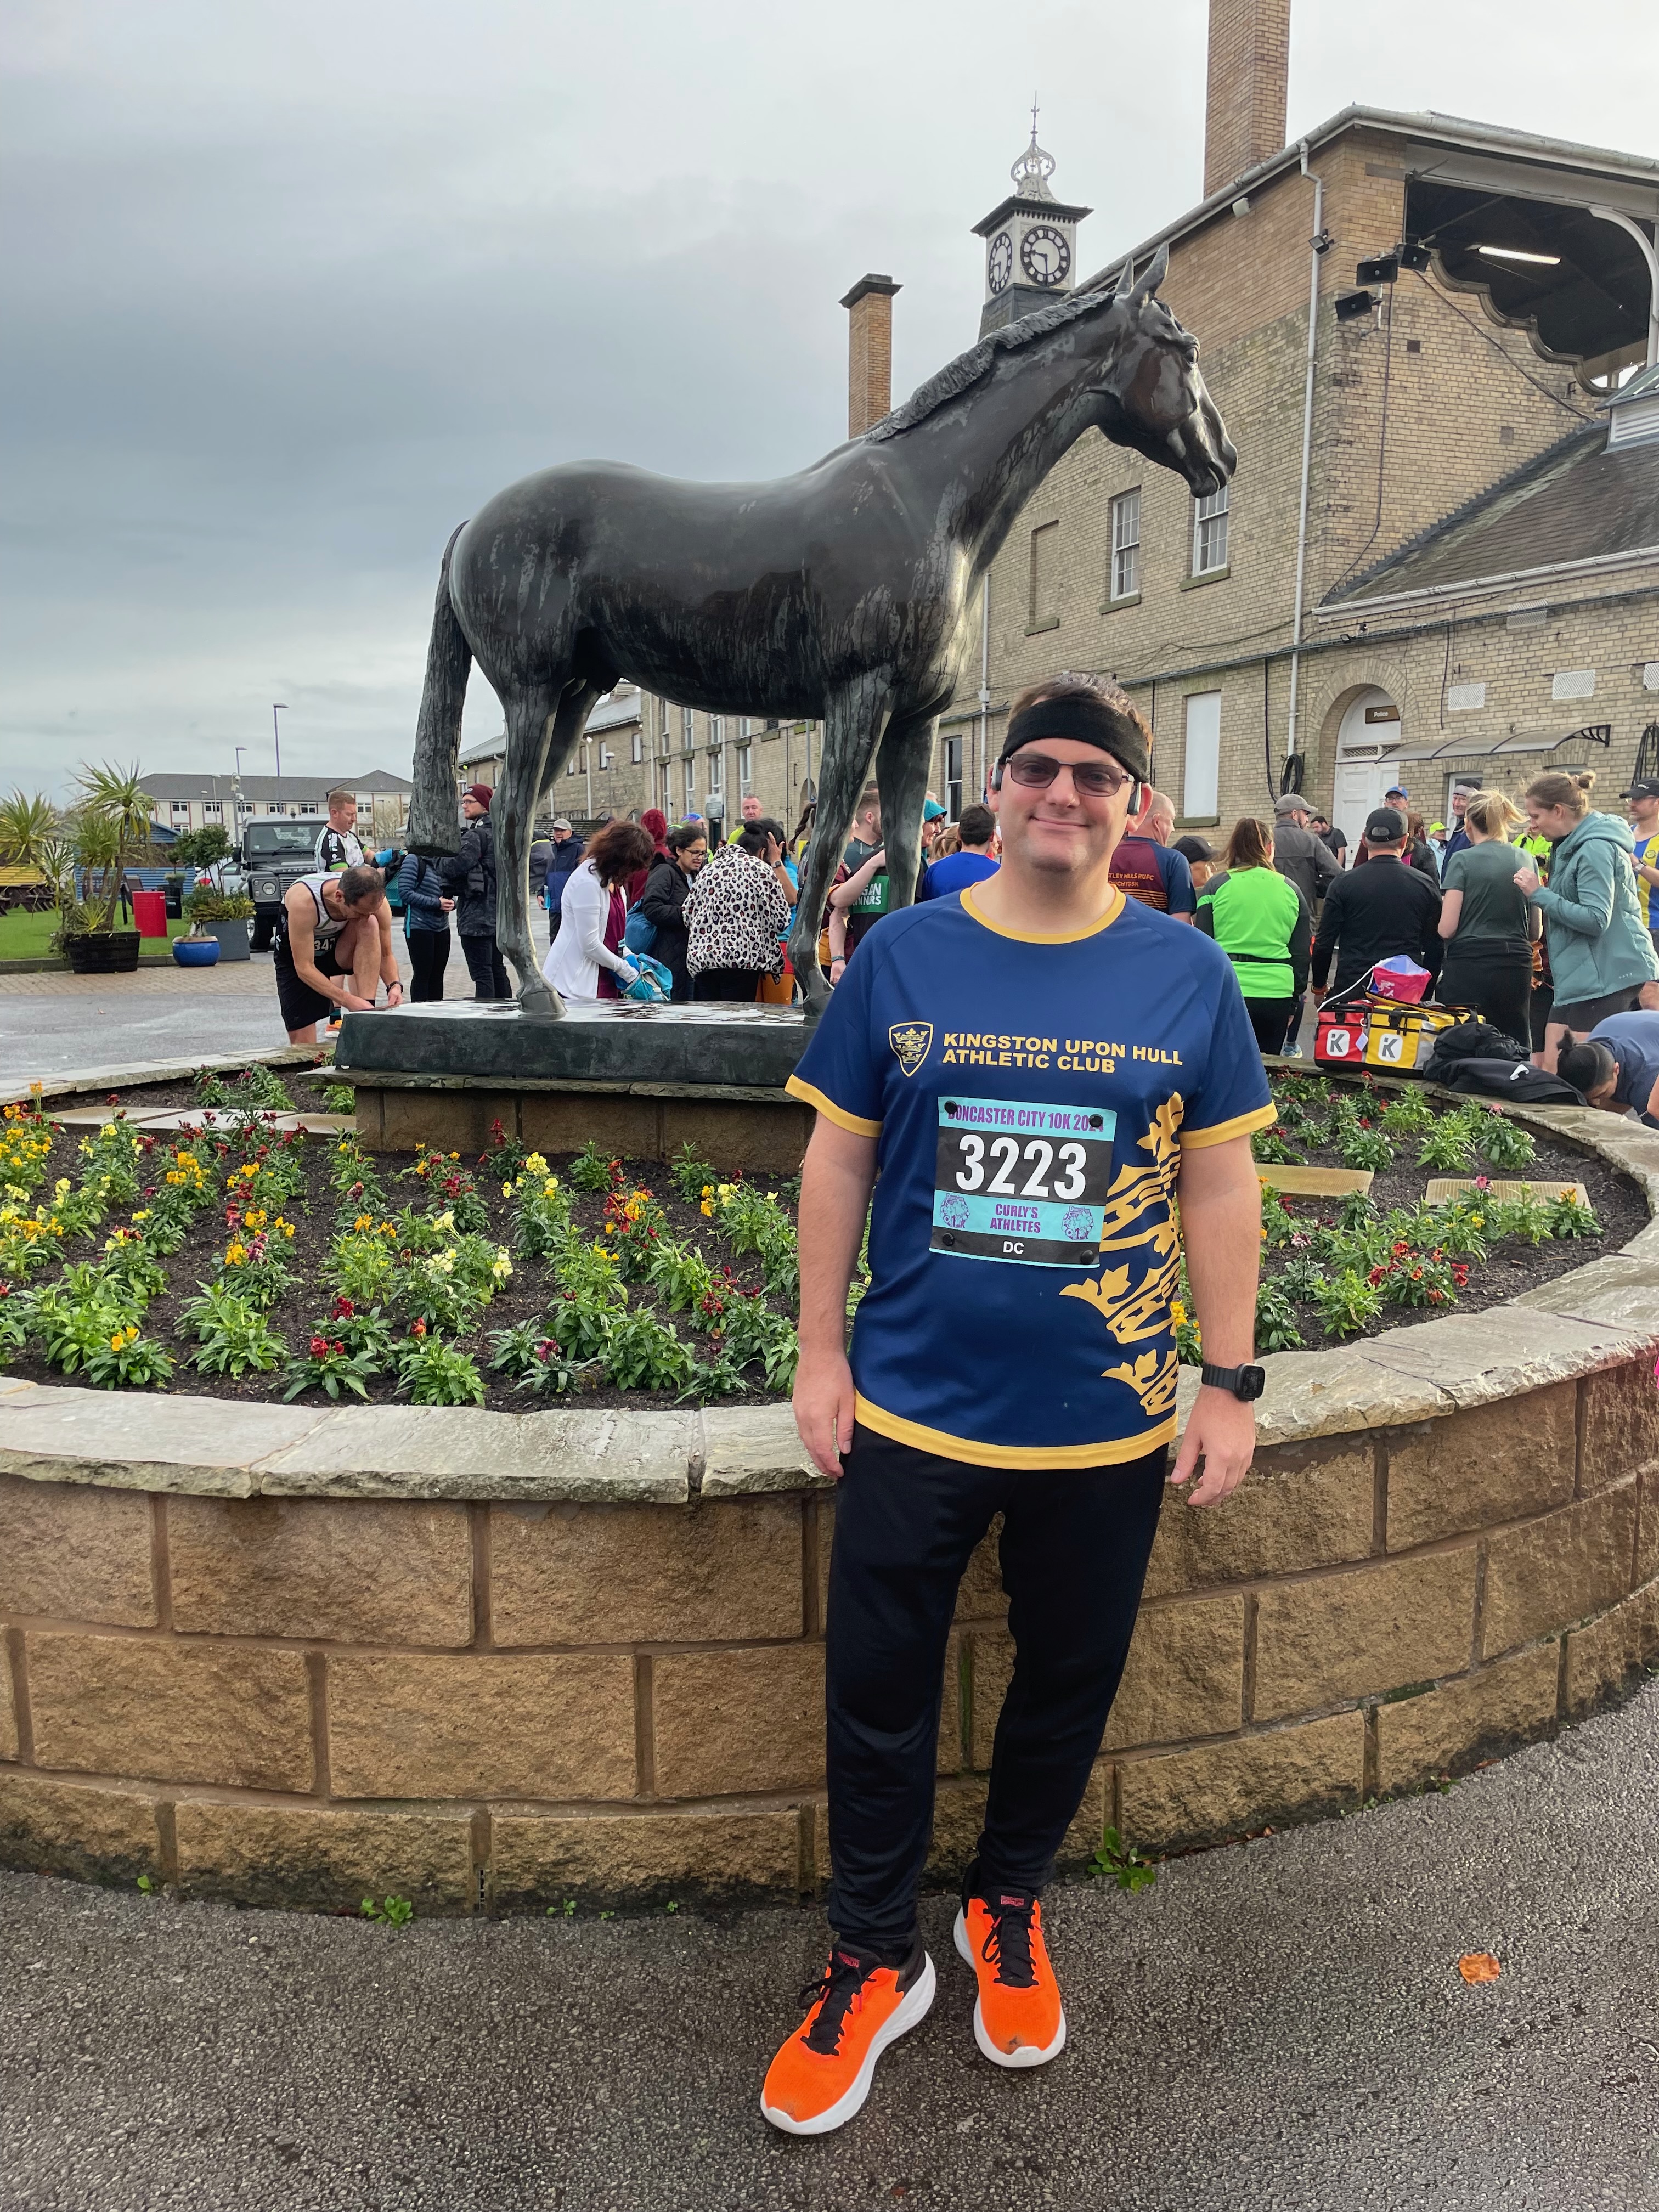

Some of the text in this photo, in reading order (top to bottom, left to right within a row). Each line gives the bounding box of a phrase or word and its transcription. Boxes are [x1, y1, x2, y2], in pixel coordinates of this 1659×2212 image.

[861, 883, 882, 896] GAN
[943, 1032, 1183, 1066] KINGSTON UPON HULL
[941, 1049, 1116, 1074] ATHLETIC CLUB
[948, 1104, 1014, 1125] ONCASTER
[1017, 1110, 1046, 1127] CITY
[1048, 1112, 1071, 1130] 10K
[956, 1133, 1086, 1200] 3223
[995, 1203, 1039, 1219] CURLY'S
[989, 1217, 1041, 1234] ATHLETES
[1003, 1240, 1024, 1255] DC
